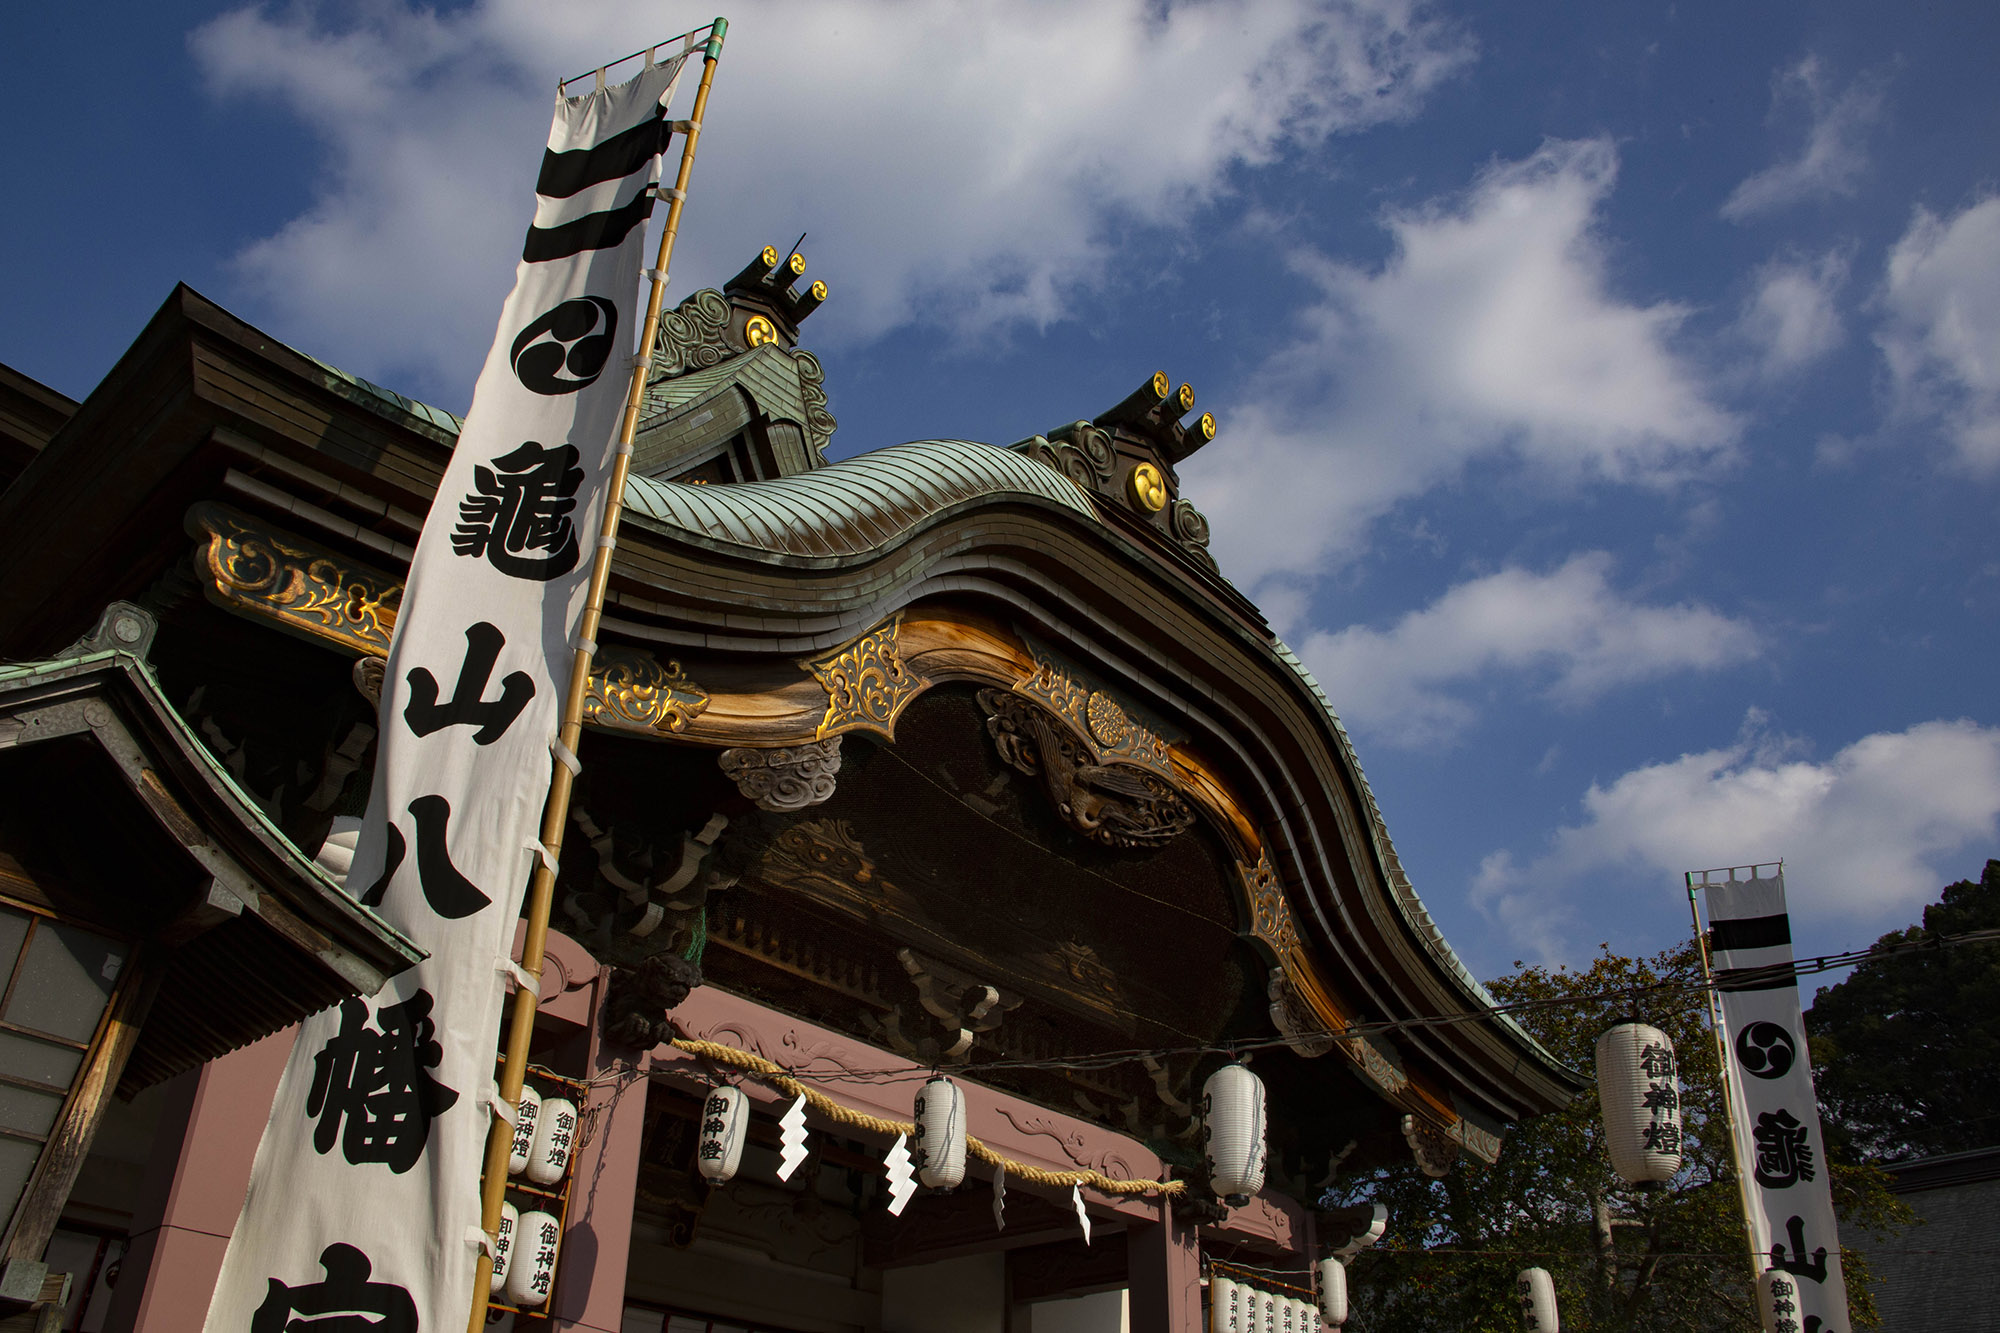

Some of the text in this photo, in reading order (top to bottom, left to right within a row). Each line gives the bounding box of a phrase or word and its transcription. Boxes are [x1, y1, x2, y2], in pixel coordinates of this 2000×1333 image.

[511, 1100, 538, 1158] 御神燈
[700, 1094, 729, 1160] 御神燈
[1640, 1041, 1680, 1156] 御神燈
[546, 1112, 574, 1168] 御神燈
[530, 1222, 558, 1294] 御神燈
